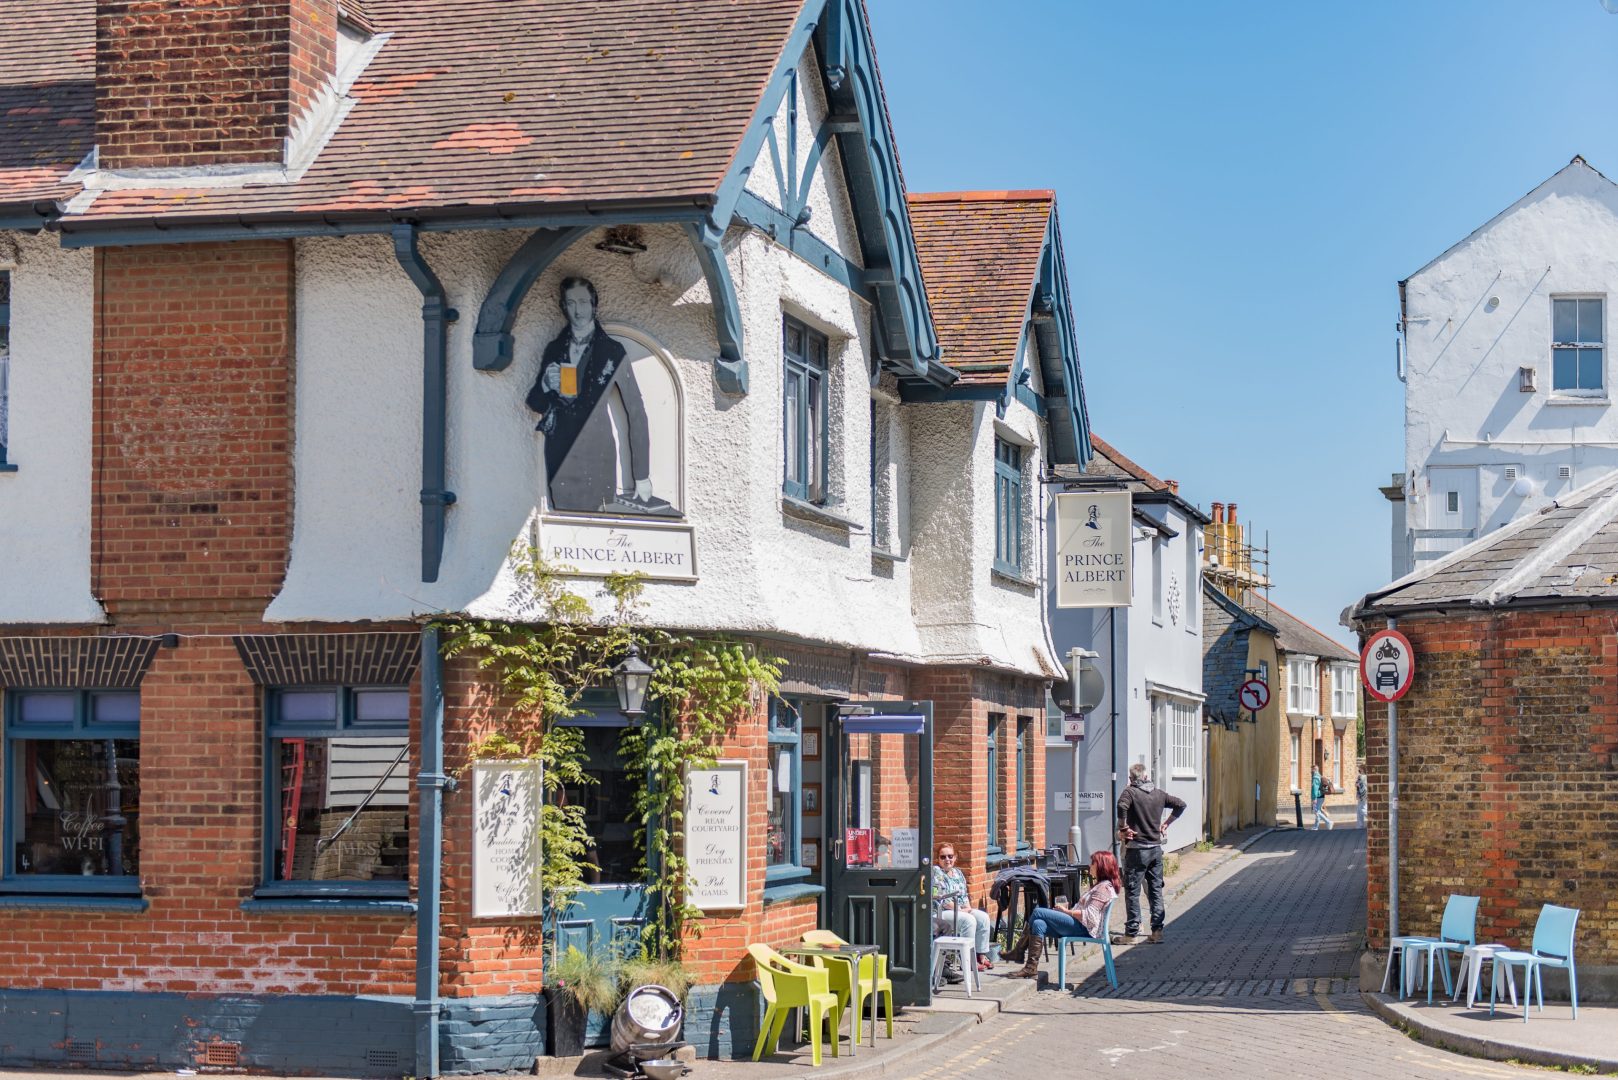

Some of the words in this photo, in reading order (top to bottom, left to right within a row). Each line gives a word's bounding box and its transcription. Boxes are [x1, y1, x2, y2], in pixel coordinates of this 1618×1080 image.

[606, 533, 633, 548] The
[1082, 535, 1105, 548] The
[553, 546, 616, 562] PRINCE
[621, 549, 684, 565] ALBERT
[1065, 553, 1125, 566] PRINCE
[1065, 569, 1126, 583] ALBERT
[60, 793, 105, 838] Coffee
[691, 824, 739, 832] COURTYARD
[61, 837, 104, 850] WI-FI
[695, 857, 733, 865] FRIENDLY
[701, 889, 729, 897] GAMES
